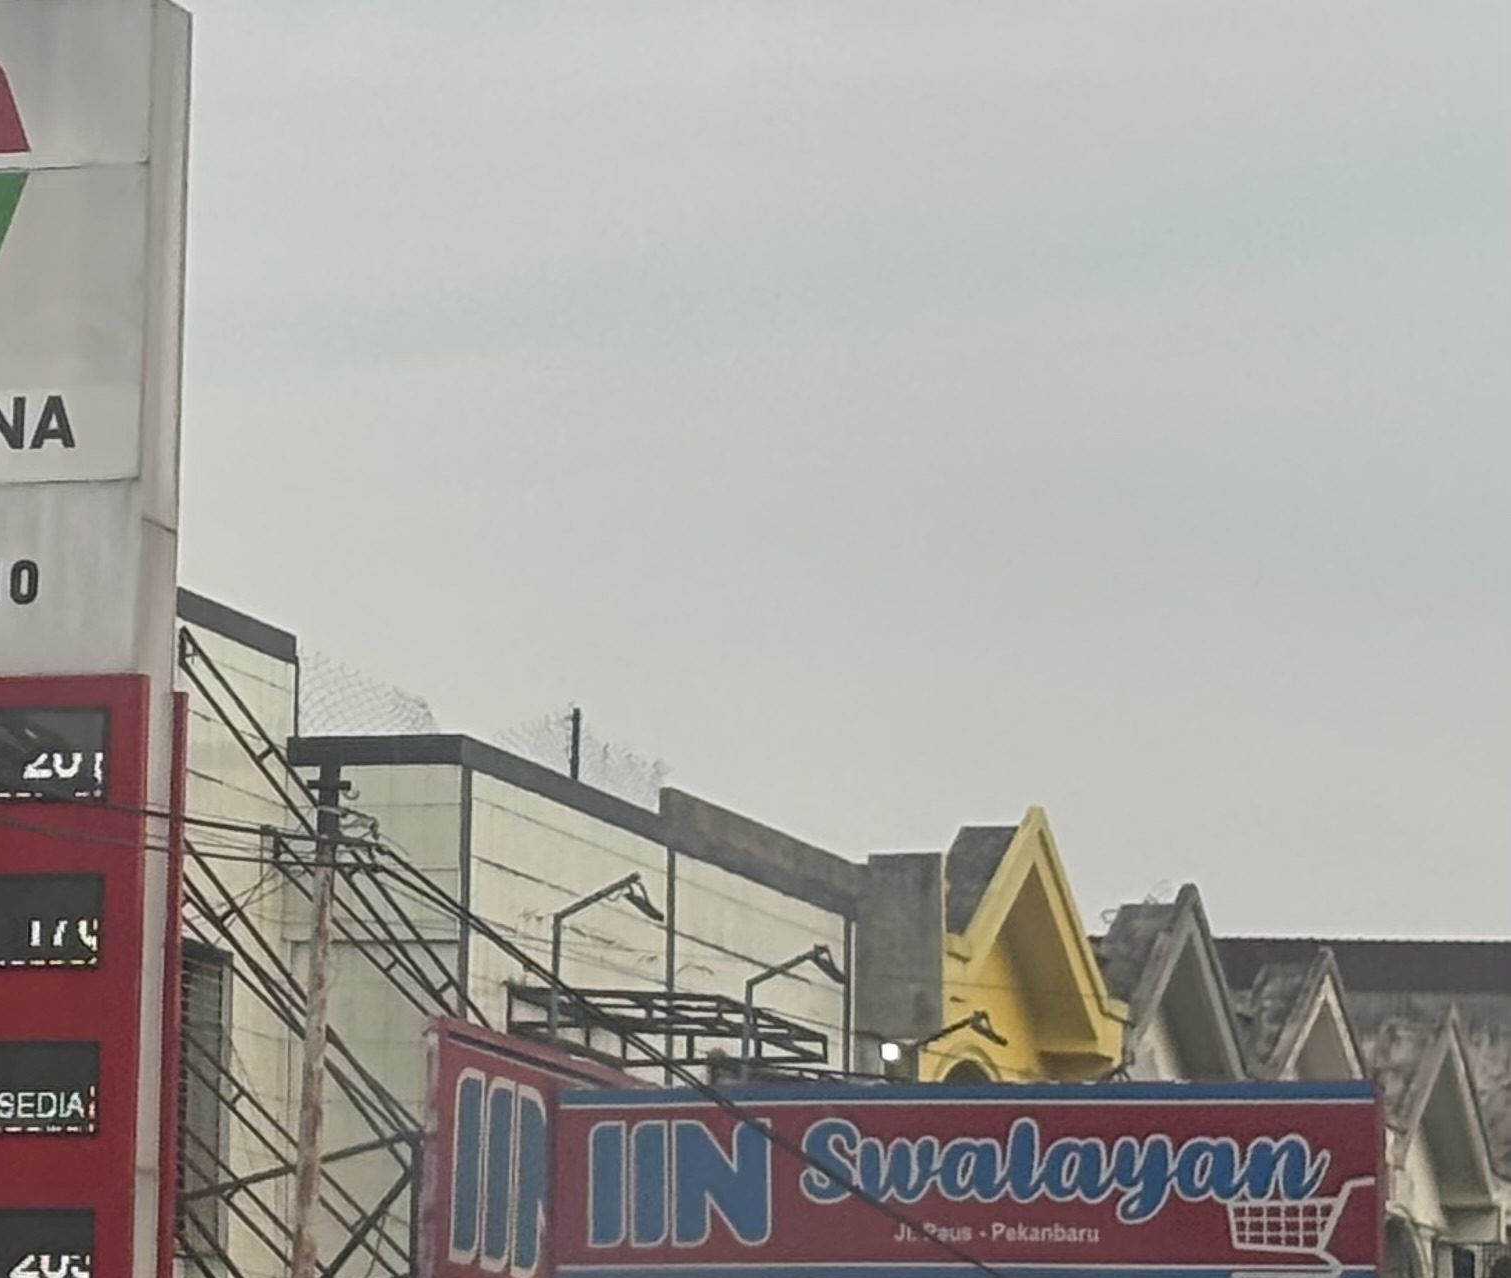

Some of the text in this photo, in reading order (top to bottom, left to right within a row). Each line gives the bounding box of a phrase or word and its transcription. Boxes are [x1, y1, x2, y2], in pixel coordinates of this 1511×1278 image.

[588, 1117, 1331, 1248] IIN Swalayan
[992, 1222, 1099, 1243] Pekanbaru
